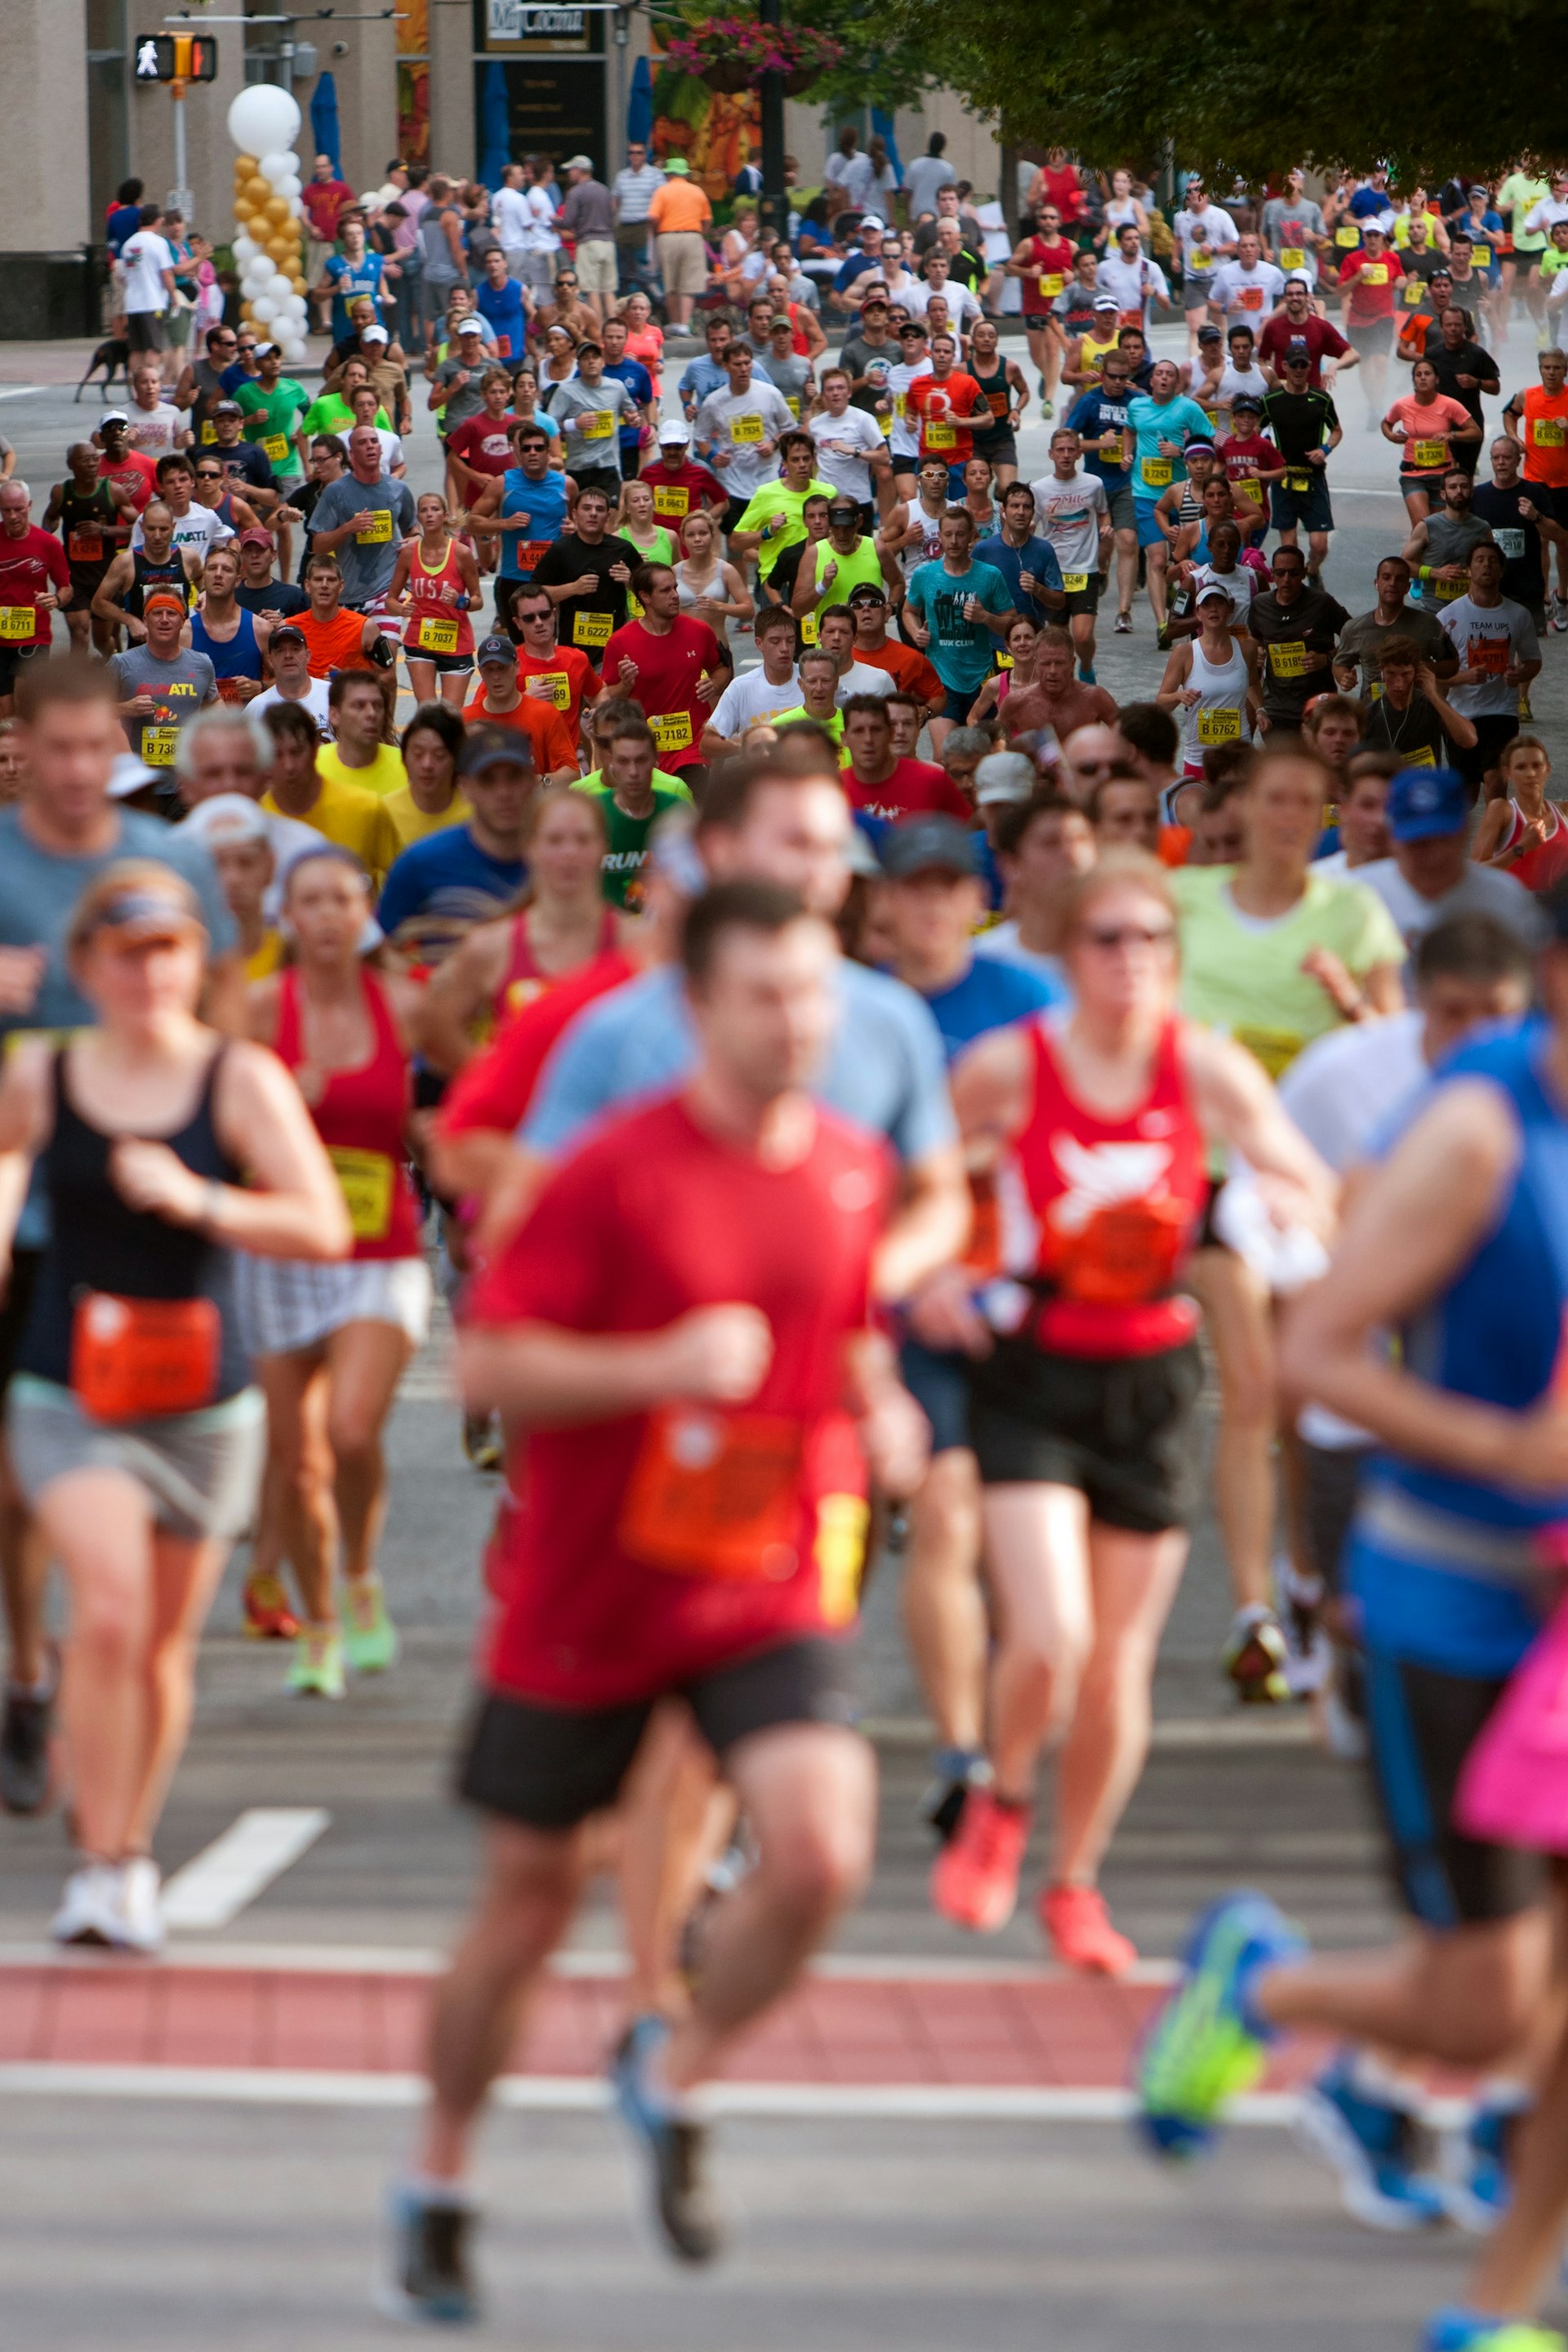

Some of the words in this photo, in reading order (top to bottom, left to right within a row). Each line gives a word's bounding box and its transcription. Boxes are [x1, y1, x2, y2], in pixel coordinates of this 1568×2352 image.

[658, 497, 664, 506] B
[1062, 494, 1087, 505] Mile
[170, 530, 208, 543] UNATL
[522, 553, 528, 562] A
[2, 620, 8, 630] B
[11, 620, 30, 630] 6711
[806, 625, 812, 634] B
[1470, 621, 1493, 630] TEAM
[1494, 622, 1510, 630] UPS
[578, 626, 585, 635] B
[587, 626, 609, 637] 6222
[424, 631, 430, 640] B
[434, 631, 453, 644] 7037
[1275, 657, 1281, 668] B
[654, 732, 661, 741] B
[666, 728, 688, 740] 7182
[1203, 724, 1209, 734] B
[1213, 724, 1236, 735] 6762
[147, 743, 154, 754] B
[158, 743, 176, 755] 738
